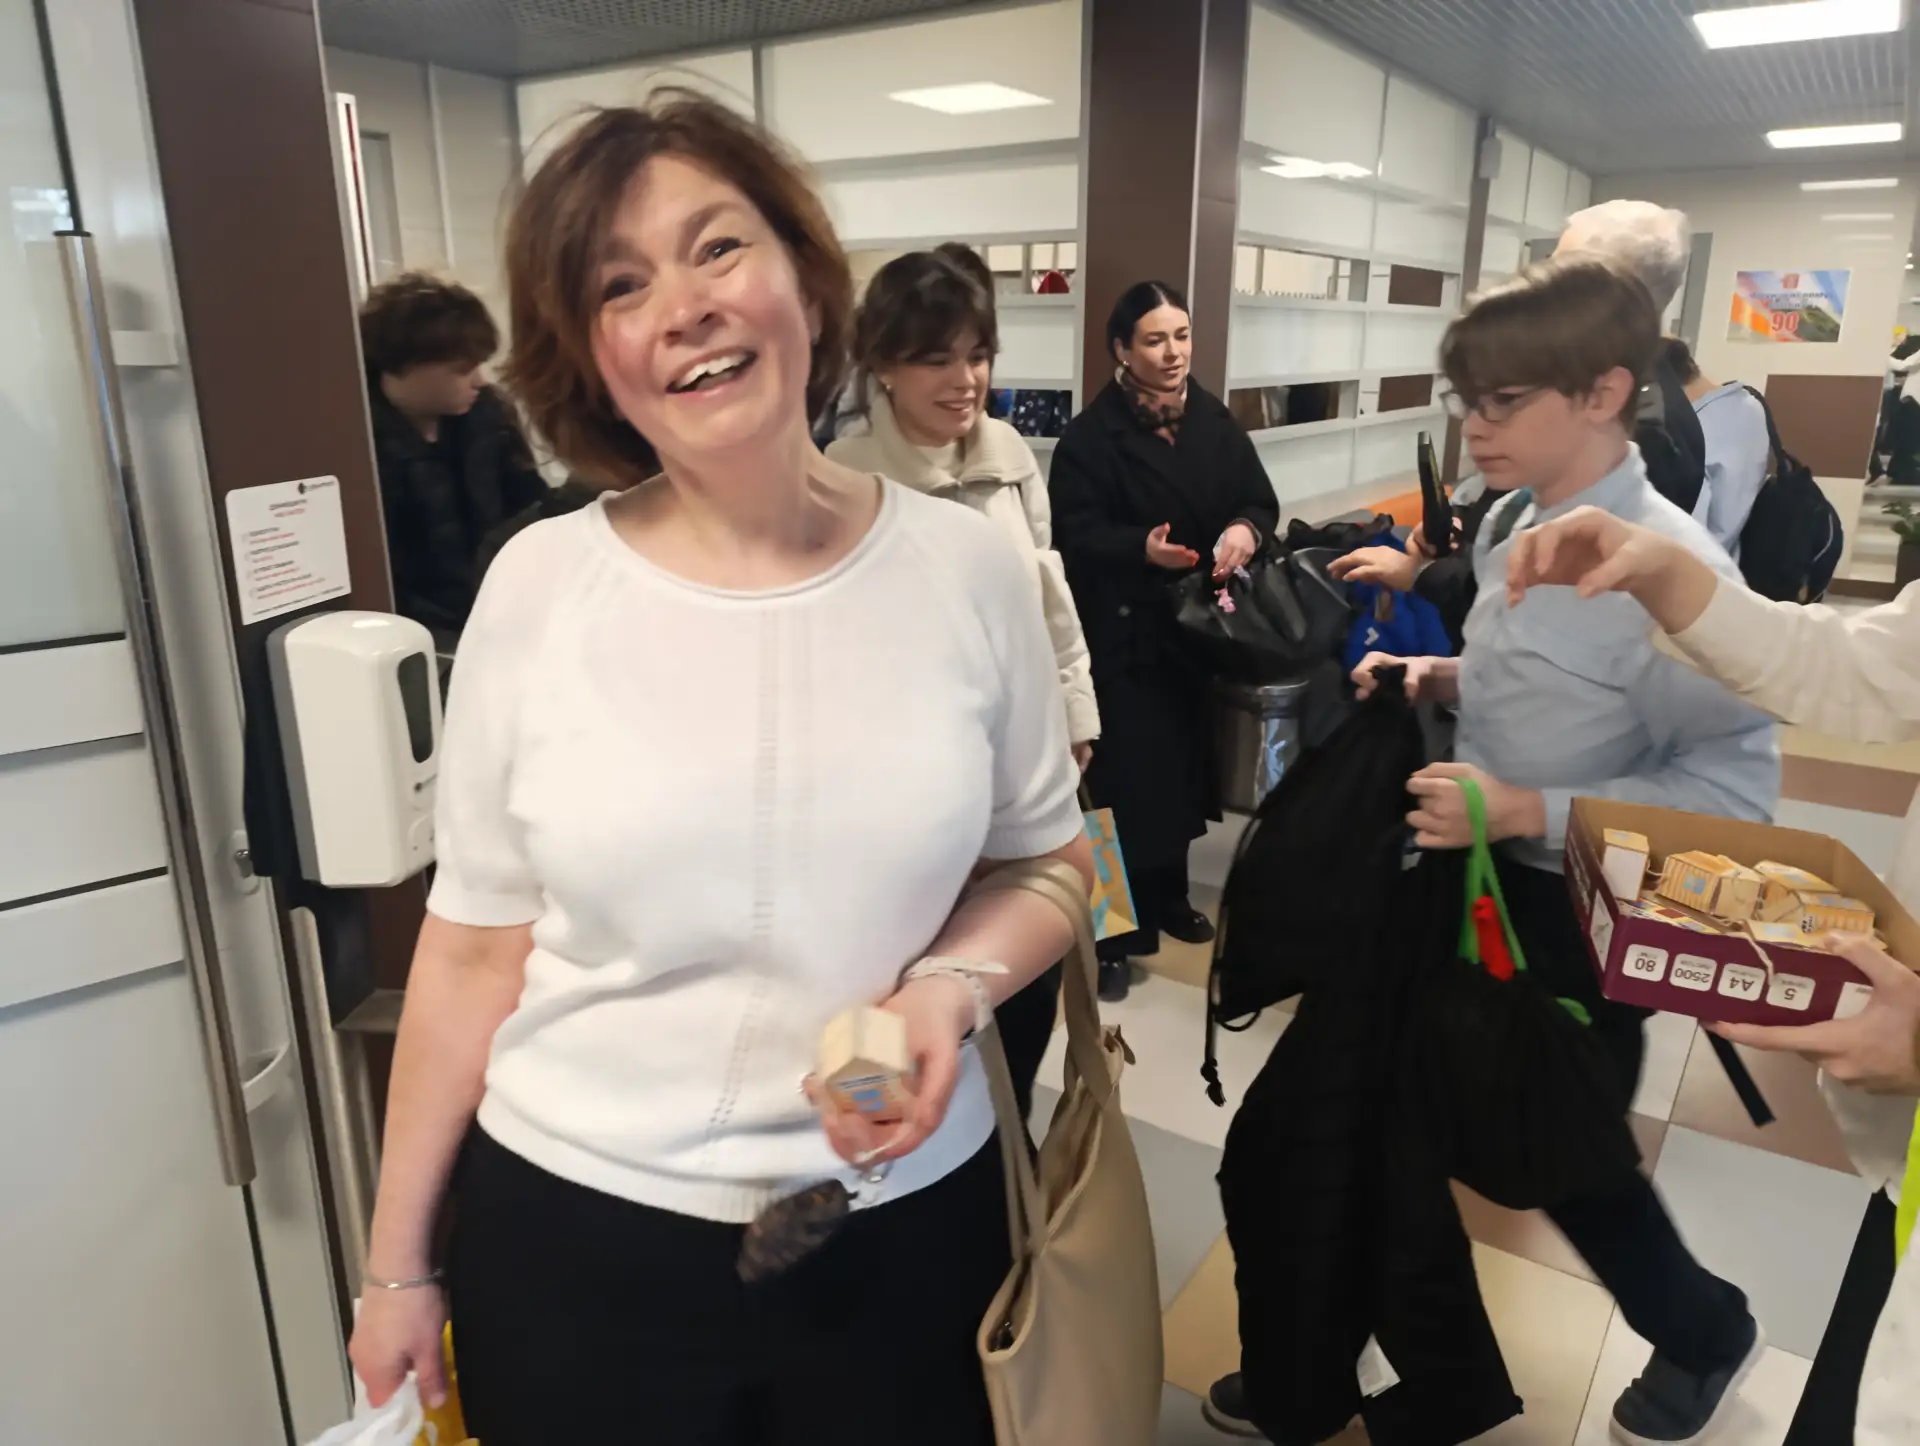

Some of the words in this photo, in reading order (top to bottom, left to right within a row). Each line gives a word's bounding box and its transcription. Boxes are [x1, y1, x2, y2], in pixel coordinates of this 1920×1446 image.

[1772, 311, 1800, 331] 90
[1635, 958, 1656, 972] 80
[1674, 967, 1711, 984] 2500
[1729, 977, 1755, 991] A4
[1784, 988, 1798, 1000] 5
